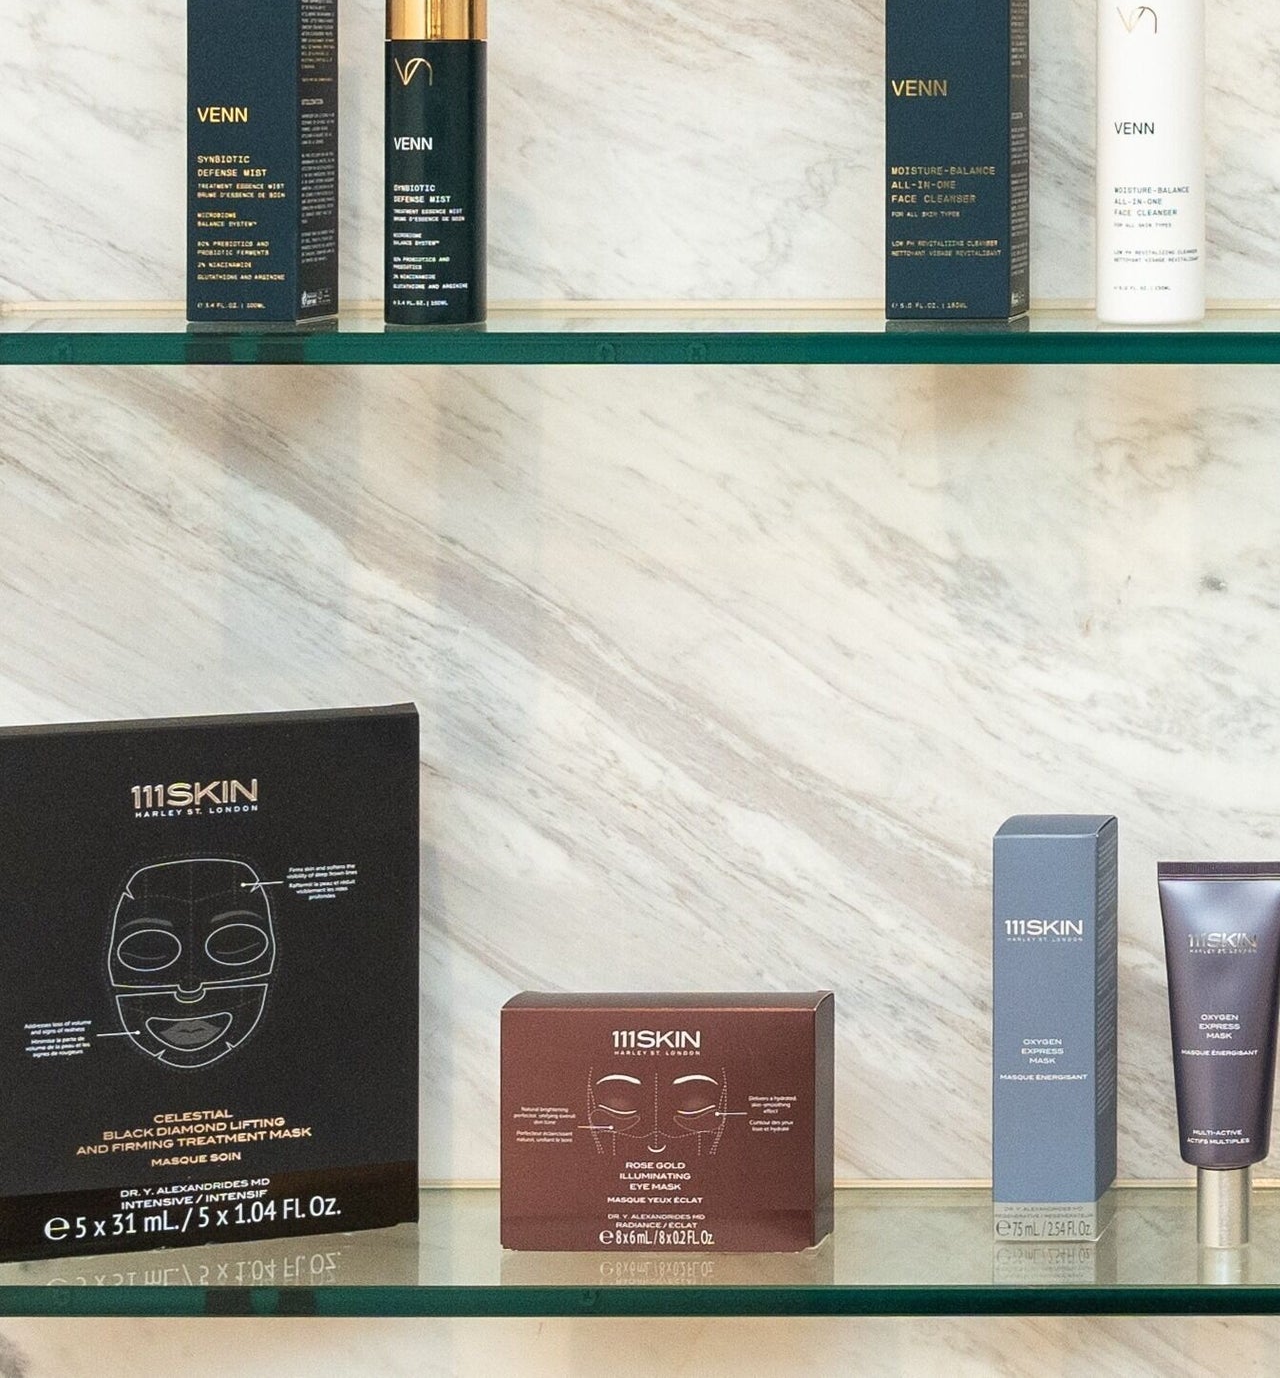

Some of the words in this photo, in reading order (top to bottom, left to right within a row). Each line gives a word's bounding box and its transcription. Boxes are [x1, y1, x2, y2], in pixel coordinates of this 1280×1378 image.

[891, 80, 947, 97] VENN
[197, 106, 248, 122] VENN
[1114, 121, 1155, 135] VENN
[393, 136, 433, 151] VENN
[197, 155, 250, 164] SYNBIOTIC
[197, 169, 238, 177] DEFENSE
[243, 169, 267, 177] MIST
[891, 166, 996, 175] MOISTURE-BALANCE
[891, 180, 956, 190] ALL-IN-ONE
[1114, 186, 1190, 194] MOISTURE-BALANCE
[393, 195, 425, 203] DEFENSE
[429, 195, 451, 203] MIST
[891, 194, 917, 203] FACE
[924, 194, 977, 203] CLEANSER
[1114, 209, 1132, 217] FACE
[1136, 209, 1178, 217] CLEANSER
[130, 778, 258, 809] 111SKIN
[135, 809, 182, 818] HARLEY
[187, 808, 203, 816] ST.
[209, 804, 259, 814] LONDON
[1004, 919, 1084, 936] 111SKIN
[1188, 931, 1258, 948] 111SKIN
[1201, 1013, 1239, 1022] OXYGEN
[1198, 1023, 1241, 1031] EXPRESS
[612, 1030, 701, 1049] 111SKIN
[1023, 1038, 1063, 1046] OXYGEN
[1206, 1032, 1232, 1040] MASK
[153, 1109, 234, 1124] CELESTIAL
[103, 1127, 155, 1141] BLACK
[155, 1121, 227, 1136] DIAMOND
[230, 1116, 285, 1130] LIFTING
[76, 1143, 109, 1156] AND
[112, 1137, 174, 1152] FIRMING
[176, 1131, 267, 1147] TREATMENT
[268, 1126, 313, 1141] MASK
[151, 1155, 208, 1167] MASQUE
[210, 1151, 242, 1163] SOIN
[625, 1161, 654, 1170] ROSE
[656, 1161, 686, 1170] GOLD
[619, 1172, 691, 1181] ILLUMINATING
[120, 1188, 142, 1198] DR.
[156, 1178, 249, 1195] ALEXANDRIDES
[250, 1177, 270, 1188] MD
[629, 1183, 650, 1191] EYE
[651, 1183, 682, 1191] MASK
[120, 1196, 192, 1211] INTENSIVE
[205, 1188, 268, 1203] INTENSIF
[75, 1216, 86, 1239] 5
[112, 1212, 137, 1235] 31
[198, 1206, 209, 1228] 5
[234, 1200, 276, 1224] 1.04
[615, 1221, 662, 1229] RADIANCE
